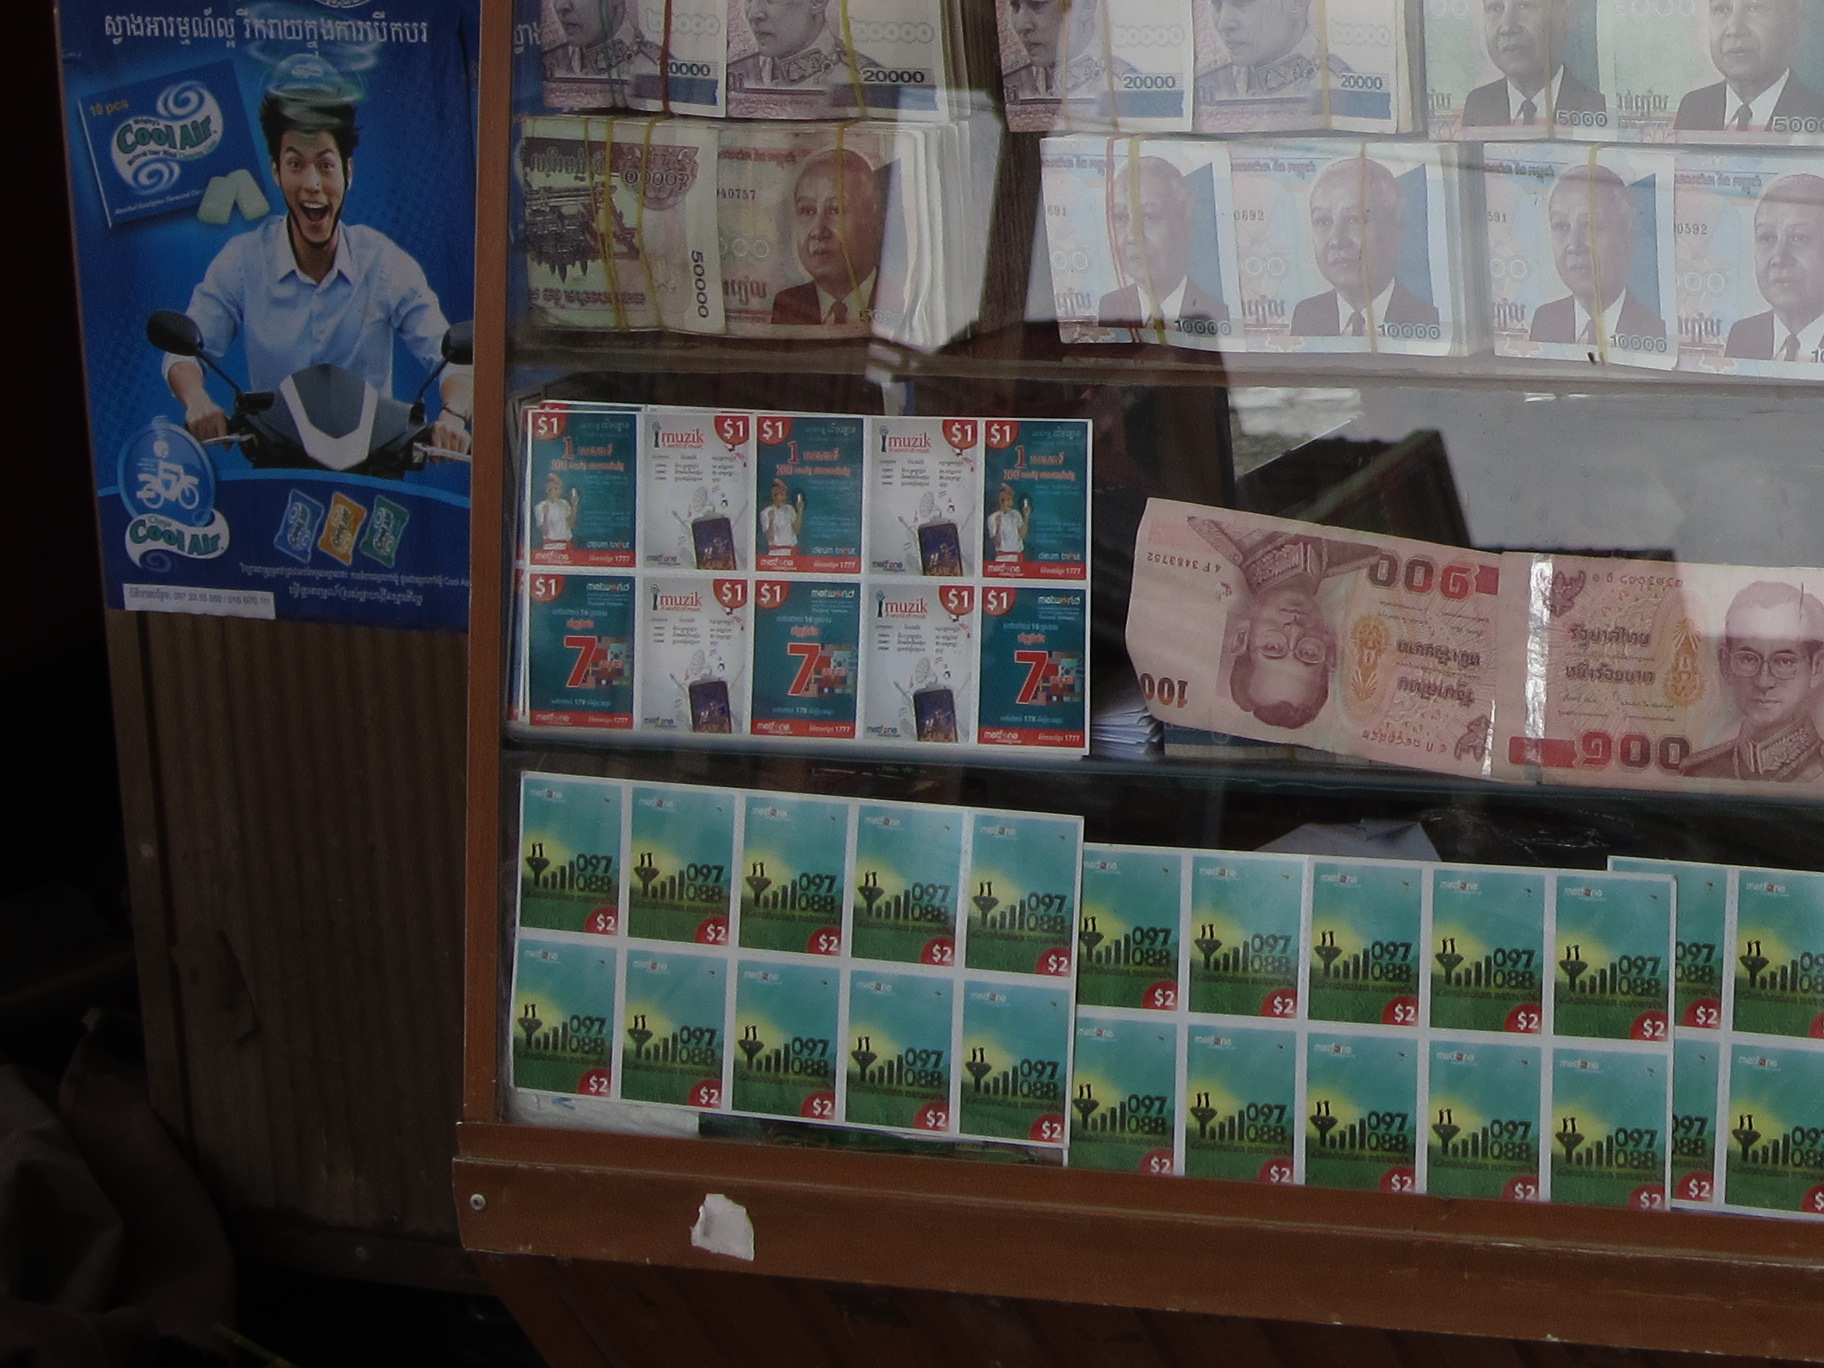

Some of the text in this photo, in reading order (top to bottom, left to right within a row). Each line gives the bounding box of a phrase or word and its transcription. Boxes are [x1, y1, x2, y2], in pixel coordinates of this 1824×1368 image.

[862, 69, 925, 85] 20000
[1123, 75, 1175, 90] 20000
[1341, 74, 1382, 90] 20000
[1557, 111, 1608, 127] 5000
[117, 115, 212, 154] Cool Air
[691, 249, 709, 320] 50000
[1174, 319, 1231, 335] 10000
[1377, 324, 1440, 339] 10000
[1609, 335, 1667, 354] 10000
[538, 415, 559, 435] $1
[723, 417, 744, 438] $1
[762, 418, 783, 438] $1
[950, 420, 972, 443] $1
[990, 422, 1011, 443] $1
[129, 519, 220, 557] Cool Air
[535, 577, 556, 598] $1
[721, 581, 743, 602] $1
[760, 583, 781, 604] $1
[948, 588, 970, 610] $1
[987, 589, 1008, 611] $1
[563, 635, 598, 688] 7
[1014, 649, 1049, 705] 7
[1141, 673, 1188, 708] 100
[575, 854, 613, 874] 097
[800, 873, 837, 893] 097
[1028, 893, 1067, 913] 097
[597, 913, 617, 933] $2
[818, 934, 839, 953] $2
[1371, 941, 1413, 961] 097
[1048, 955, 1068, 974] $2
[1394, 1003, 1417, 1023] $2
[790, 1037, 829, 1057] 097
[812, 1098, 833, 1117] $2
